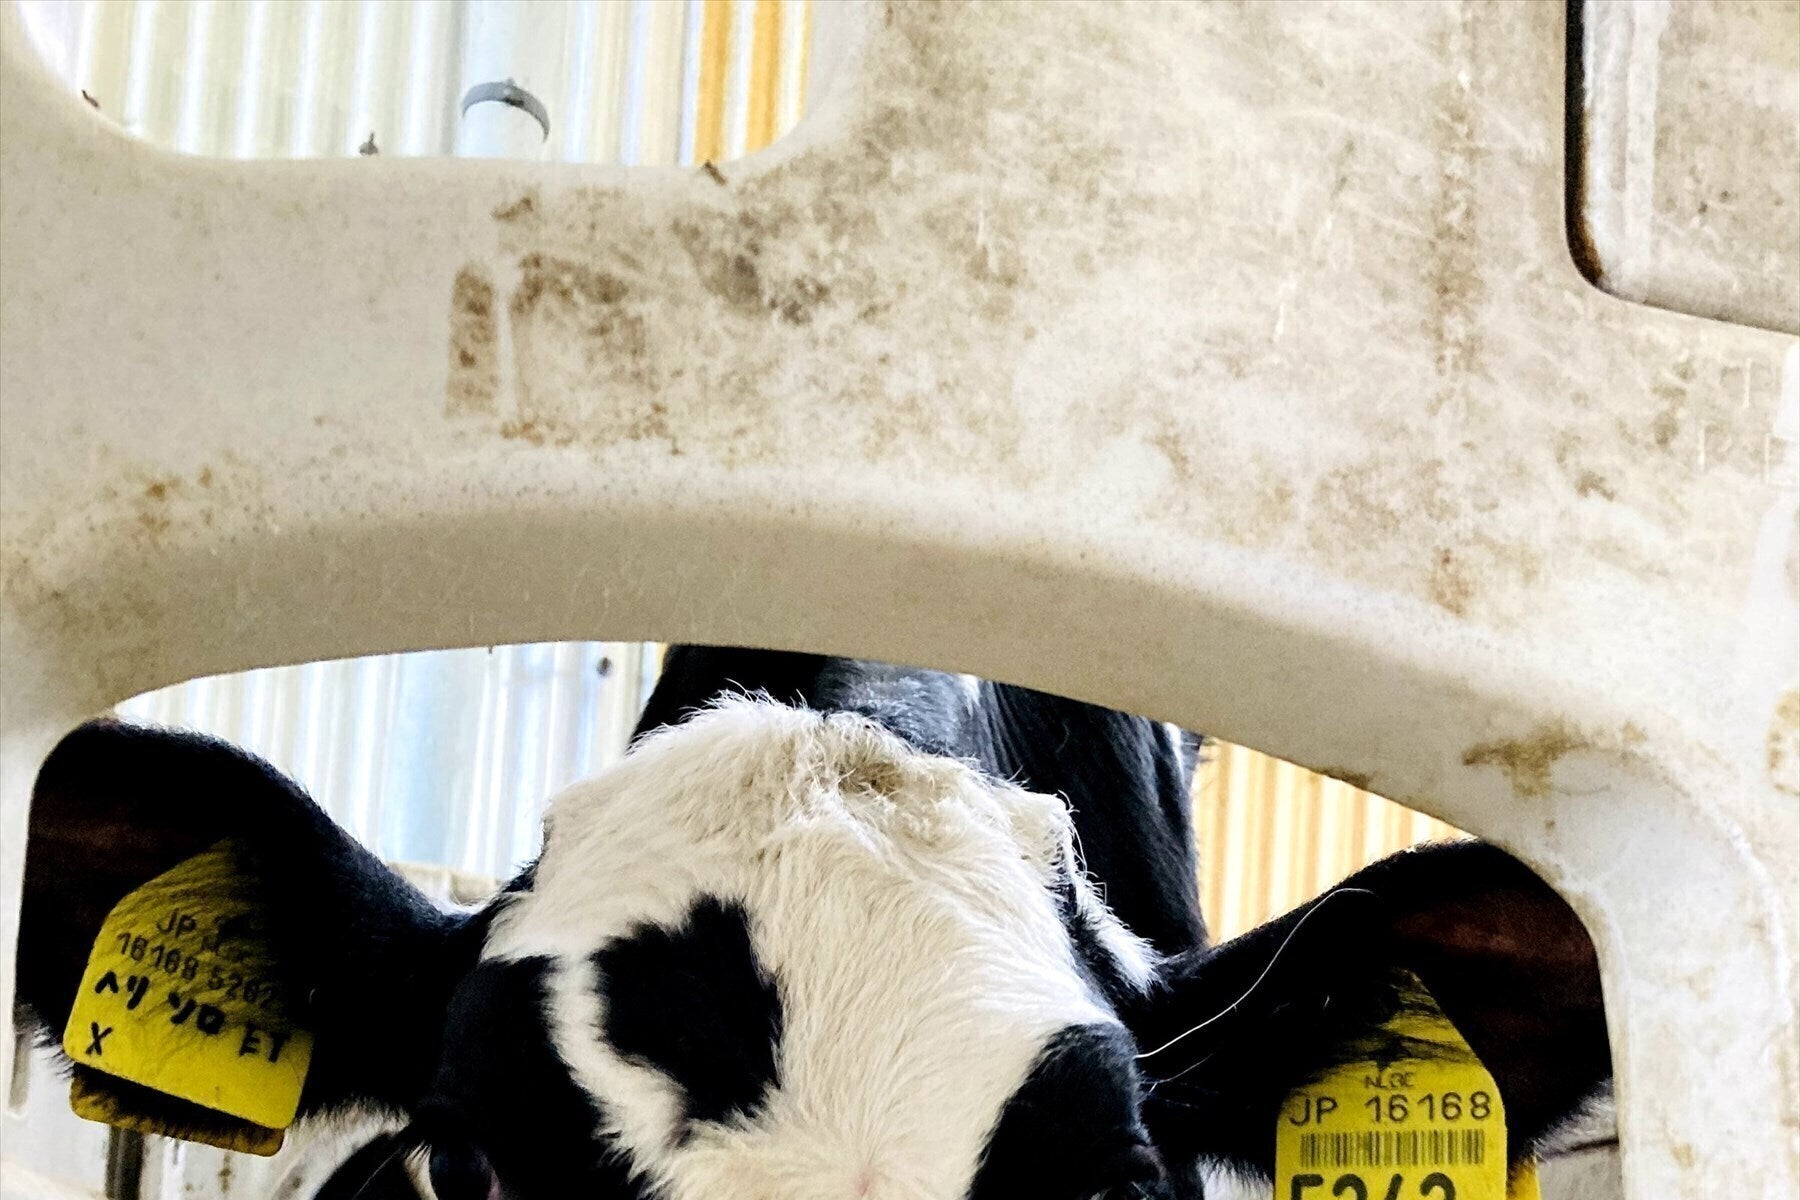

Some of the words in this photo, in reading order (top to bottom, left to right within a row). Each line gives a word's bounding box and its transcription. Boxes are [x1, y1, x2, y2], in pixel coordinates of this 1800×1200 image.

[156, 908, 196, 938] JP
[116, 932, 200, 981] 16168
[85, 1022, 113, 1056] X
[239, 1023, 291, 1063] ET
[1289, 1096, 1339, 1127] JP
[1364, 1090, 1492, 1123] 16168
